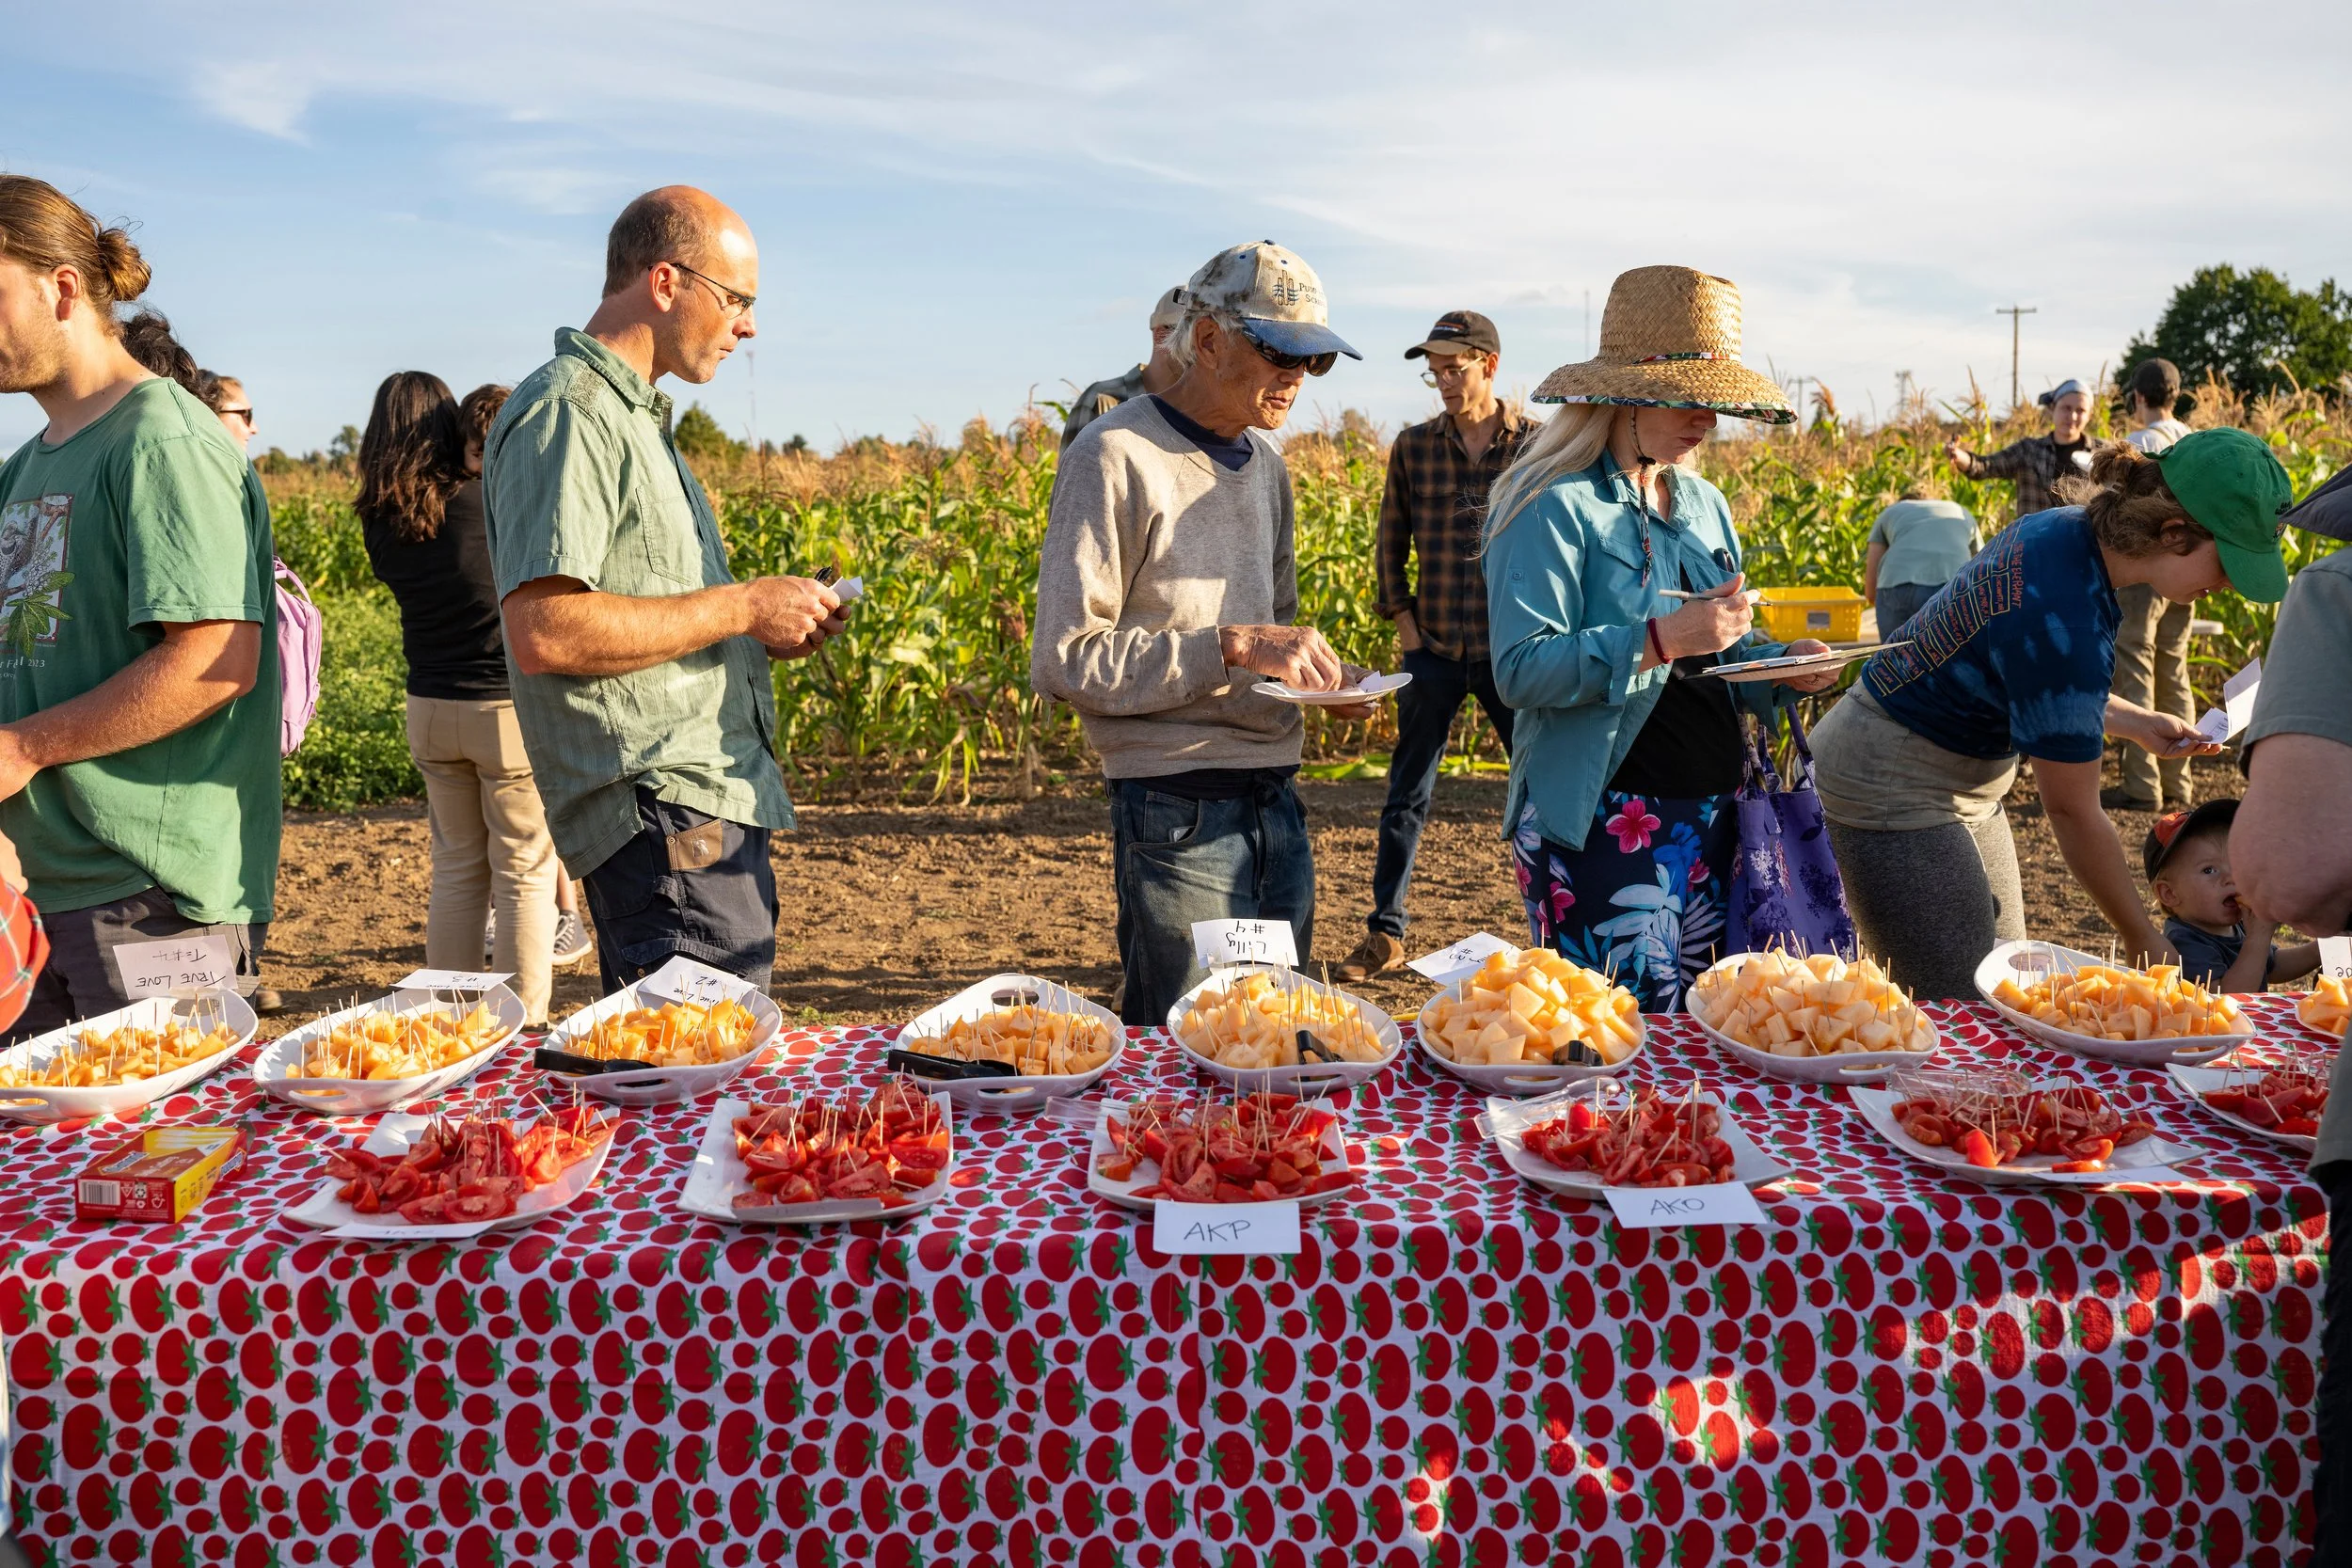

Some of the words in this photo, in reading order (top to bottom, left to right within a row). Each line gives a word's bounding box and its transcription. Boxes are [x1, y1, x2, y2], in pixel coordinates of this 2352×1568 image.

[2011, 567, 2025, 610] ELEPHANT
[135, 975, 171, 990] LOVE
[1184, 1219, 1251, 1242] AKP
